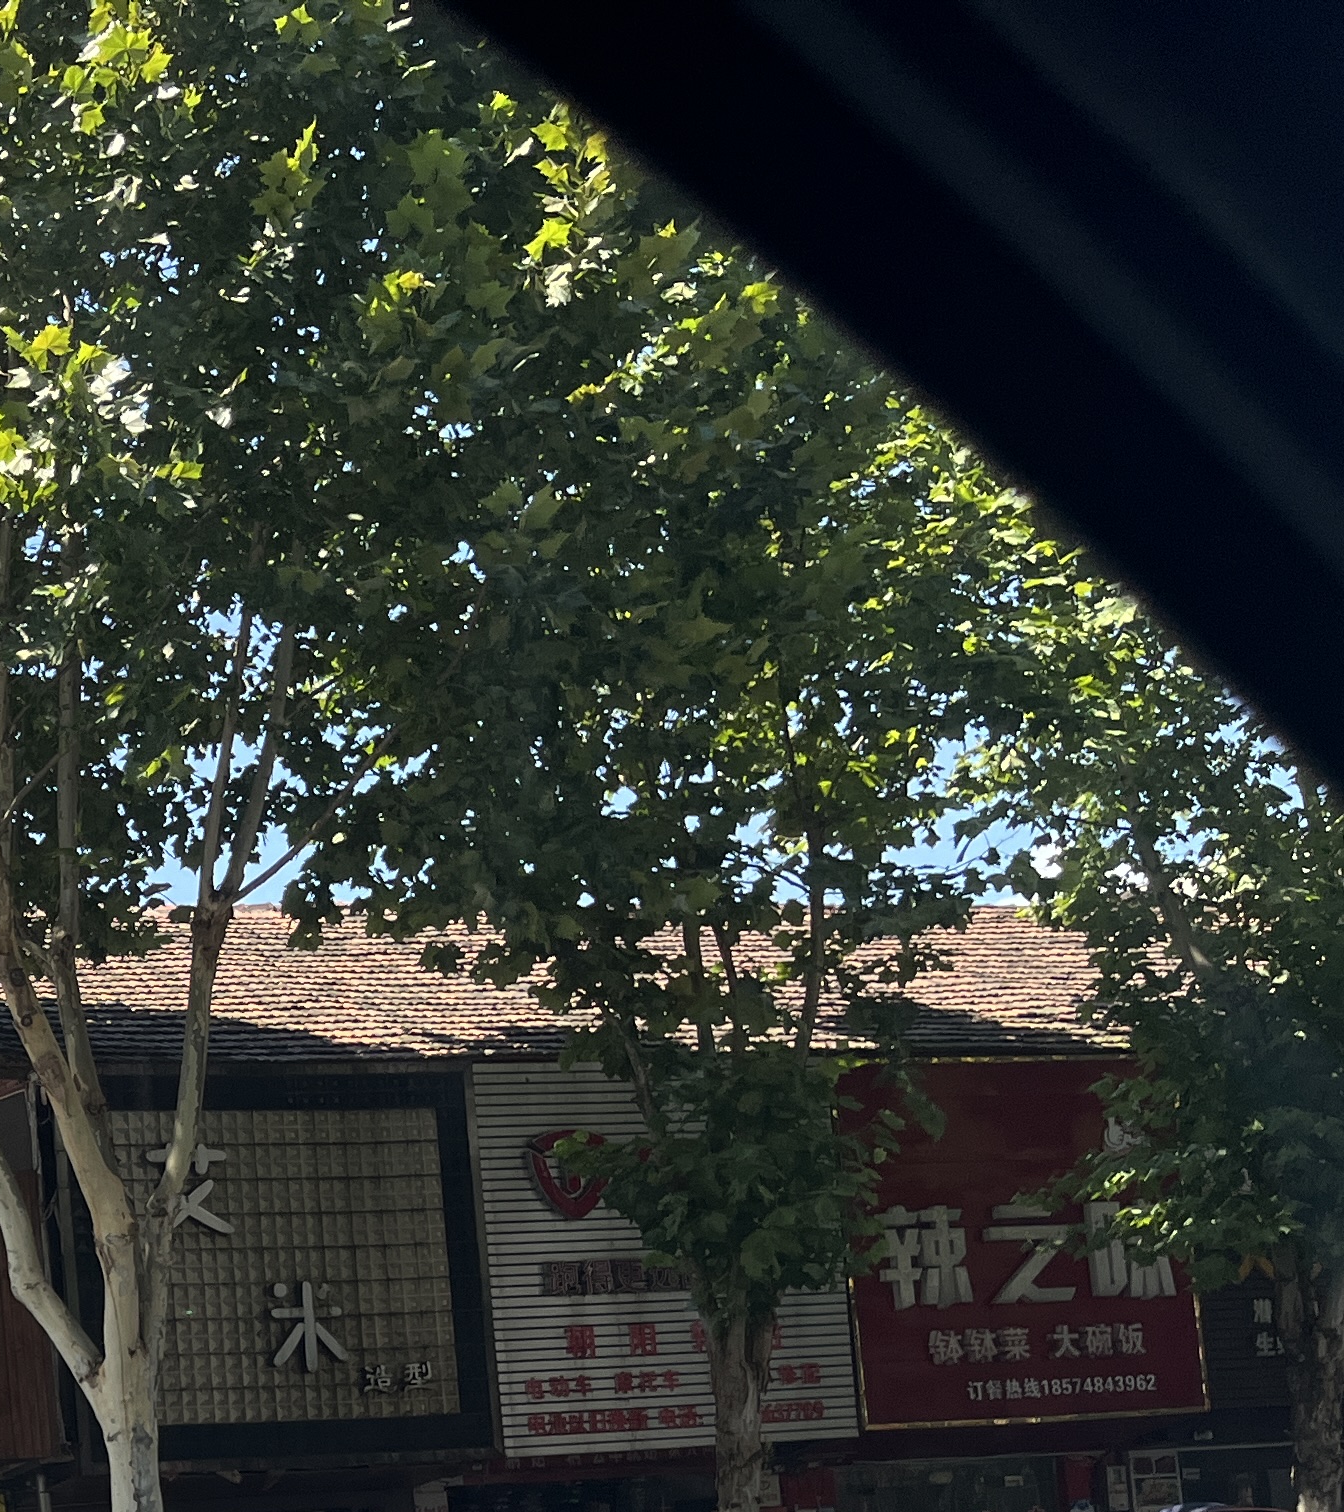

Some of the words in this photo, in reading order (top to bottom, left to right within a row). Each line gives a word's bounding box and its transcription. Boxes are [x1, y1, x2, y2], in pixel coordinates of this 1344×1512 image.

[929, 1325, 1031, 1365] 钵钵菜
[1050, 1321, 1148, 1359] 大碗饭
[361, 1360, 434, 1396] 造型
